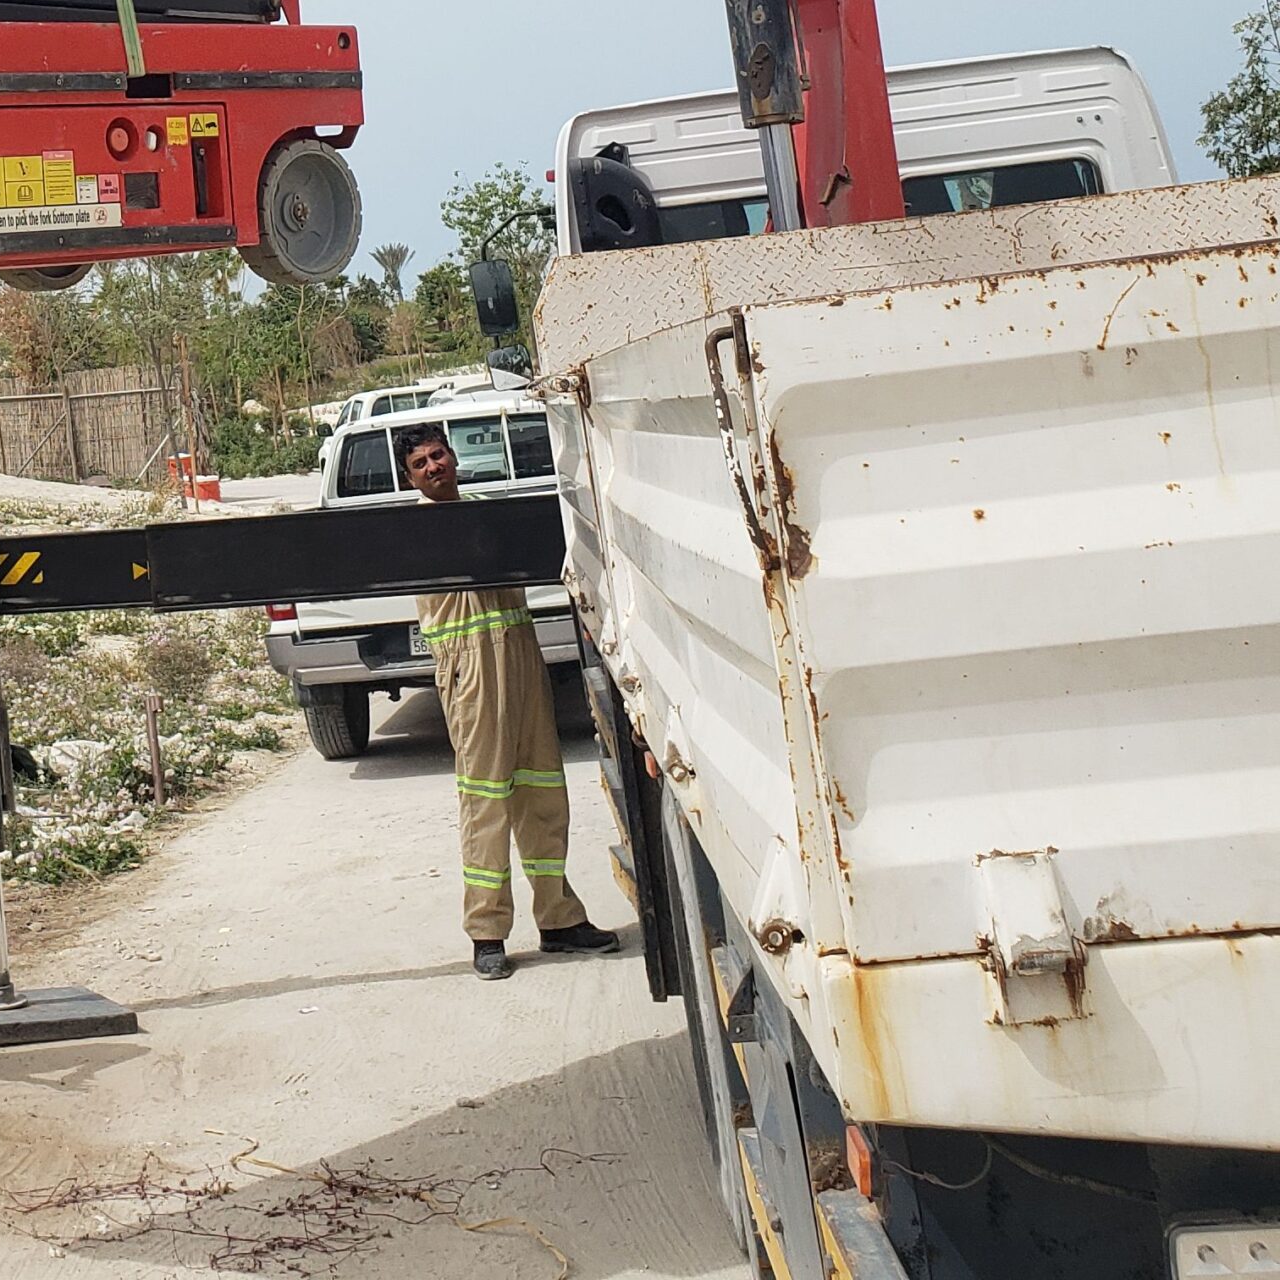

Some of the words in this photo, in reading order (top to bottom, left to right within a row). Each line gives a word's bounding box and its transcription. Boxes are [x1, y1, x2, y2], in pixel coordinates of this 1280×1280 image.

[7, 214, 14, 227] to
[15, 210, 28, 230] pick
[28, 211, 39, 226] the
[39, 210, 52, 225] fork
[52, 208, 74, 225] bottom
[75, 209, 90, 227] plate
[413, 639, 432, 653] 56
